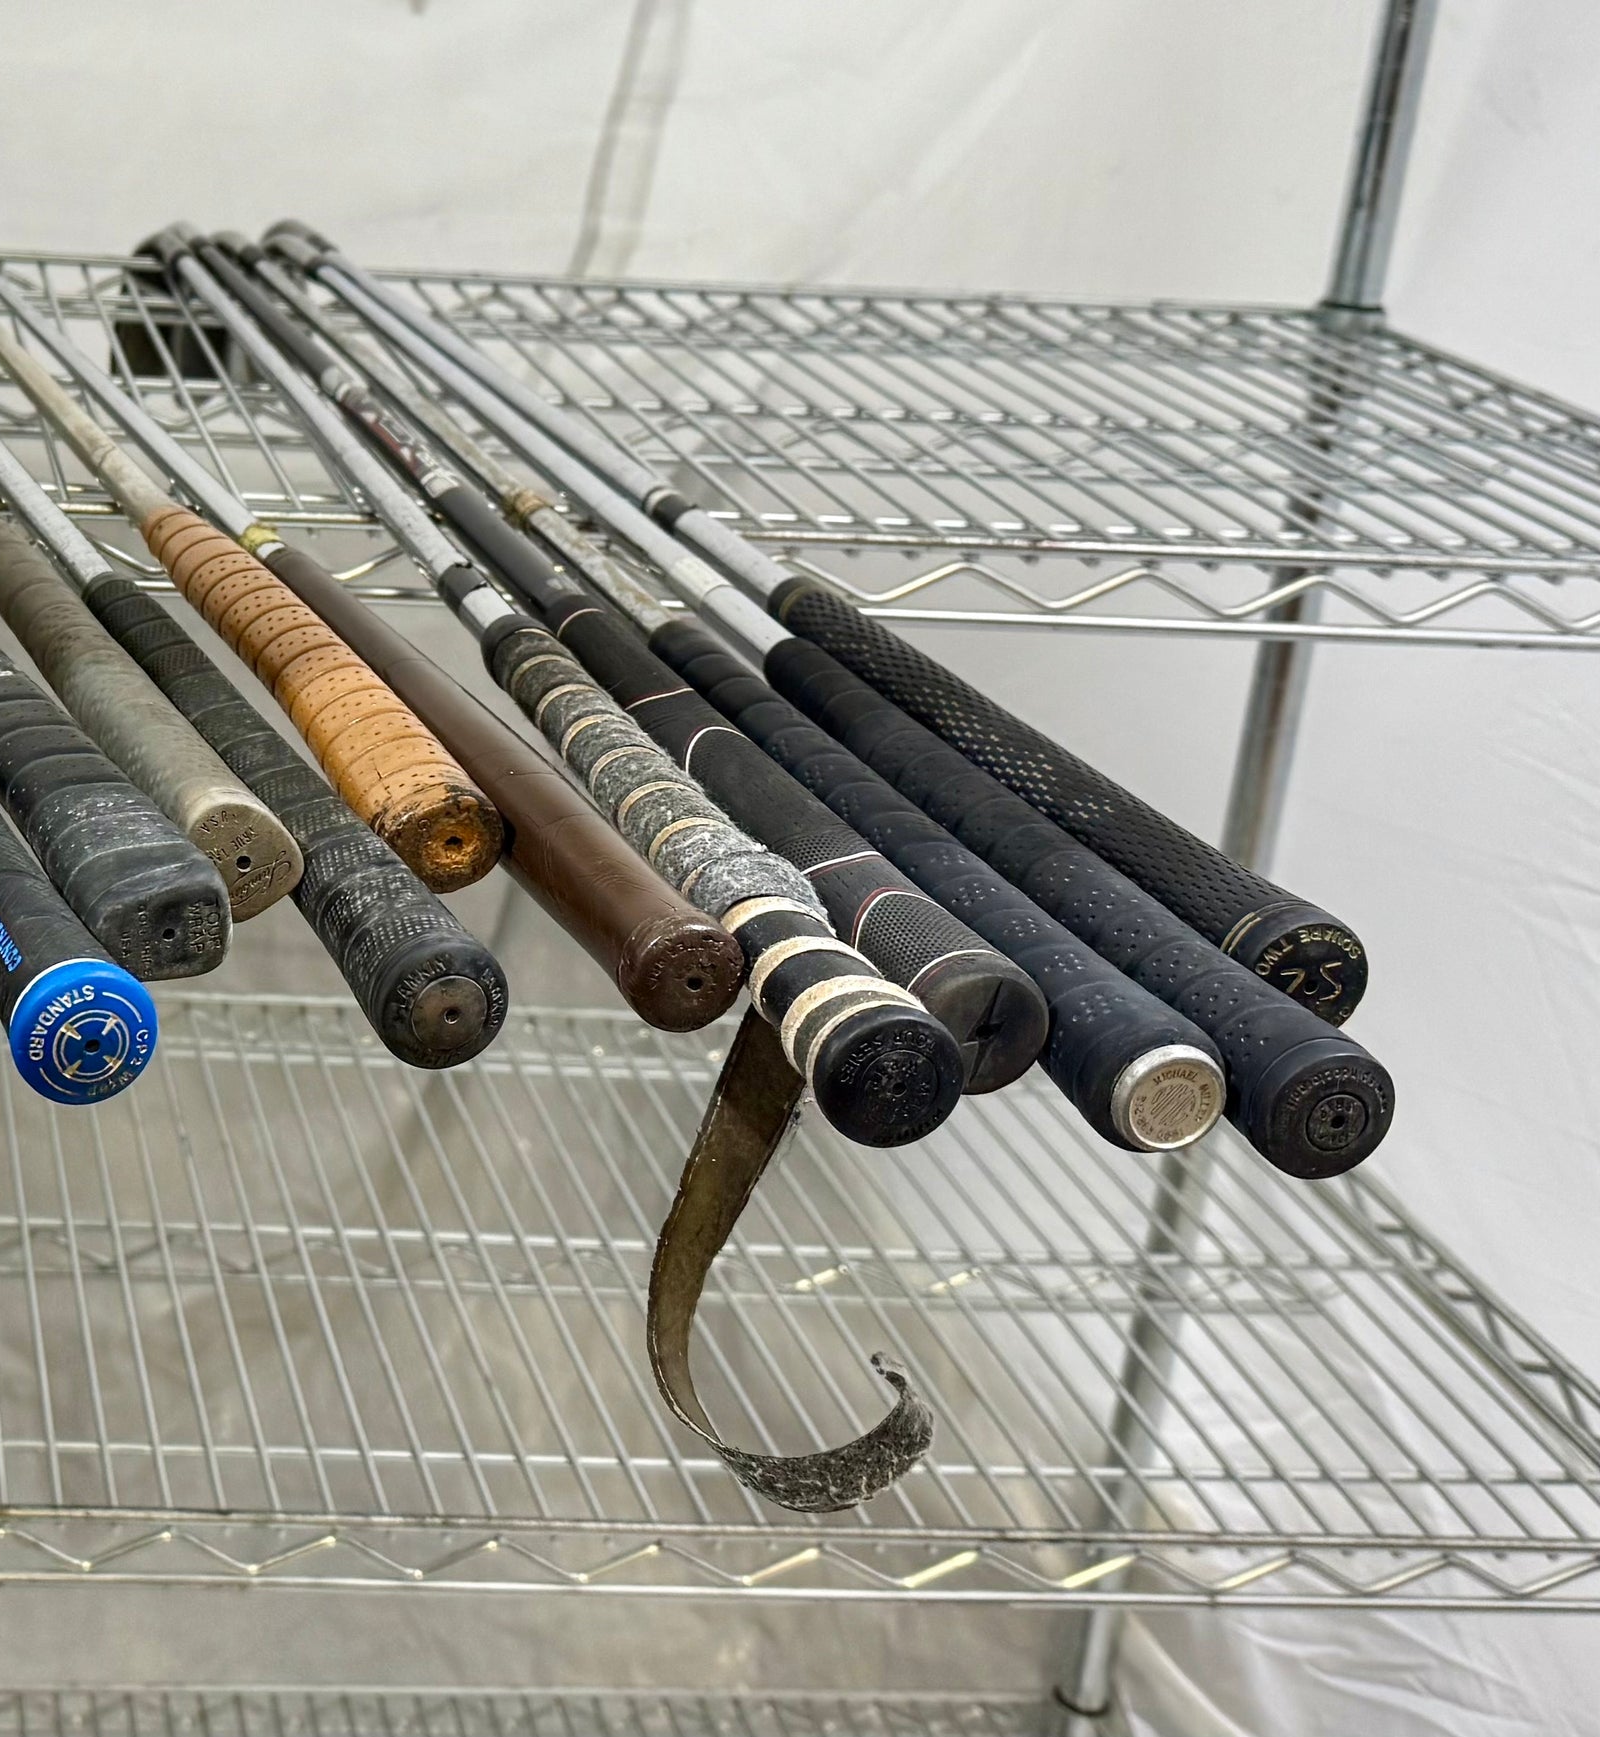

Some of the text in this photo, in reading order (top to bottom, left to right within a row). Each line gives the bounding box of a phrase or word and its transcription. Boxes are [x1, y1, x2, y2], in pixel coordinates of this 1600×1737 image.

[1254, 928, 1361, 976] SQUARE TWO
[28, 984, 95, 1061] STANDARD
[1153, 1068, 1199, 1085] MICHAEL
